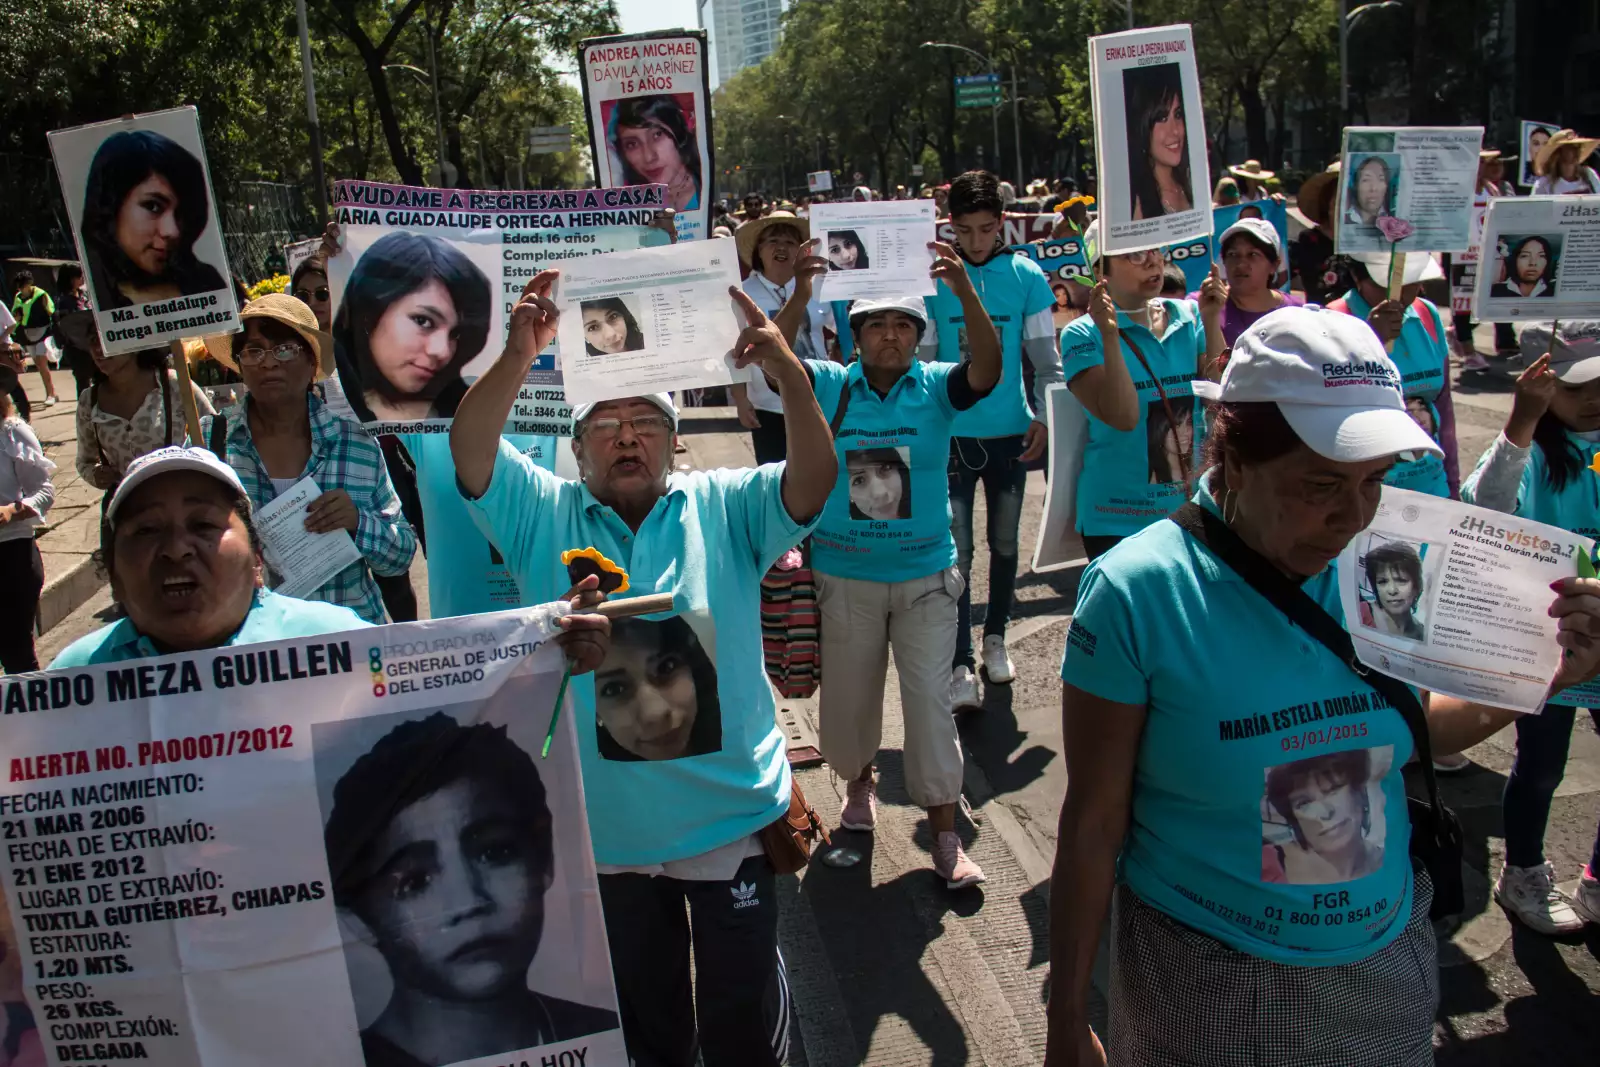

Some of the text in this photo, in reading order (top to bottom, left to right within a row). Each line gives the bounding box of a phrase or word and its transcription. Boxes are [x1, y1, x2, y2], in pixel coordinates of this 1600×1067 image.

[589, 42, 698, 64] ANDREA MICHAEL
[1105, 48, 1126, 60] ERIKA
[1127, 46, 1136, 58] DE
[1137, 45, 1145, 56] LA
[1146, 43, 1165, 55] PIEDRA
[593, 63, 641, 82] DÁVILA
[621, 75, 673, 93] 15 AÑOS
[448, 193, 463, 209] A
[469, 193, 577, 210] REGRESAR
[584, 194, 599, 208] A
[604, 187, 663, 207] CASA!
[386, 211, 492, 228] GUADALUPE
[496, 214, 564, 229] ORTEGA
[503, 231, 596, 244] Edad: 16 años
[1036, 241, 1080, 260] los
[111, 294, 217, 323] Ma. Guadalupe
[106, 311, 232, 342] Ortega Hernandez
[1324, 379, 1372, 388] buscando
[514, 404, 532, 416] Tel.:
[534, 407, 555, 418] 5346
[870, 521, 888, 529] FGR
[1449, 528, 1558, 565] María Estela Durán Ayala
[1453, 541, 1470, 550] Sexo:
[1449, 558, 1476, 568] Estatura:
[1451, 550, 1466, 558] Edad
[1466, 554, 1488, 563] actual:
[1445, 573, 1460, 582] Ojos:
[1447, 565, 1460, 573] Tez:
[1442, 581, 1467, 591] Cabello:
[1439, 597, 1492, 612] Señas particulares:
[1441, 589, 1457, 598] Fecha
[1466, 595, 1500, 606] nacimiento:
[384, 629, 496, 658] PROCURADURÍA
[107, 660, 203, 704] MEZA
[212, 641, 353, 689] GUILLEN
[386, 658, 461, 677] GENERAL
[464, 649, 485, 667] DE
[389, 668, 484, 695] DEL ESTADO
[1219, 712, 1272, 741] MARÍA
[1271, 701, 1323, 731] ESTELA
[1323, 690, 1370, 718] DURÁN
[1281, 722, 1368, 752] 03/01/2015
[9, 724, 293, 783] ALERTA NO. PA0007/2012
[0, 773, 204, 816] FECHA NACIMIENTO:
[2, 804, 145, 840] 21 MAR 2006
[8, 821, 216, 863] FECHA DE EXTRAVÍO:
[13, 855, 146, 887] 21 ENE 2012
[18, 868, 224, 910] LUGAR DE EXTRAVÍO:
[23, 880, 326, 932] TUXTLA GUTIÉRREZ, CHIAPAS
[733, 898, 760, 909] adidas
[1312, 890, 1350, 910] FGR
[1206, 900, 1215, 911] 01
[1218, 904, 1234, 919] 722
[1254, 919, 1266, 931] 20
[1267, 923, 1280, 936] 12
[1264, 898, 1387, 926] 01 800 00 854 00
[29, 931, 131, 955] ESTATURA:
[35, 954, 134, 979] 1.20 MTS.
[36, 982, 94, 1000] PESO:
[43, 1000, 123, 1020] 26 KGS.
[51, 1015, 179, 1042] COMPLEXIÓN:
[56, 1041, 147, 1062] DELGADA
[541, 1046, 588, 1067] HOY
